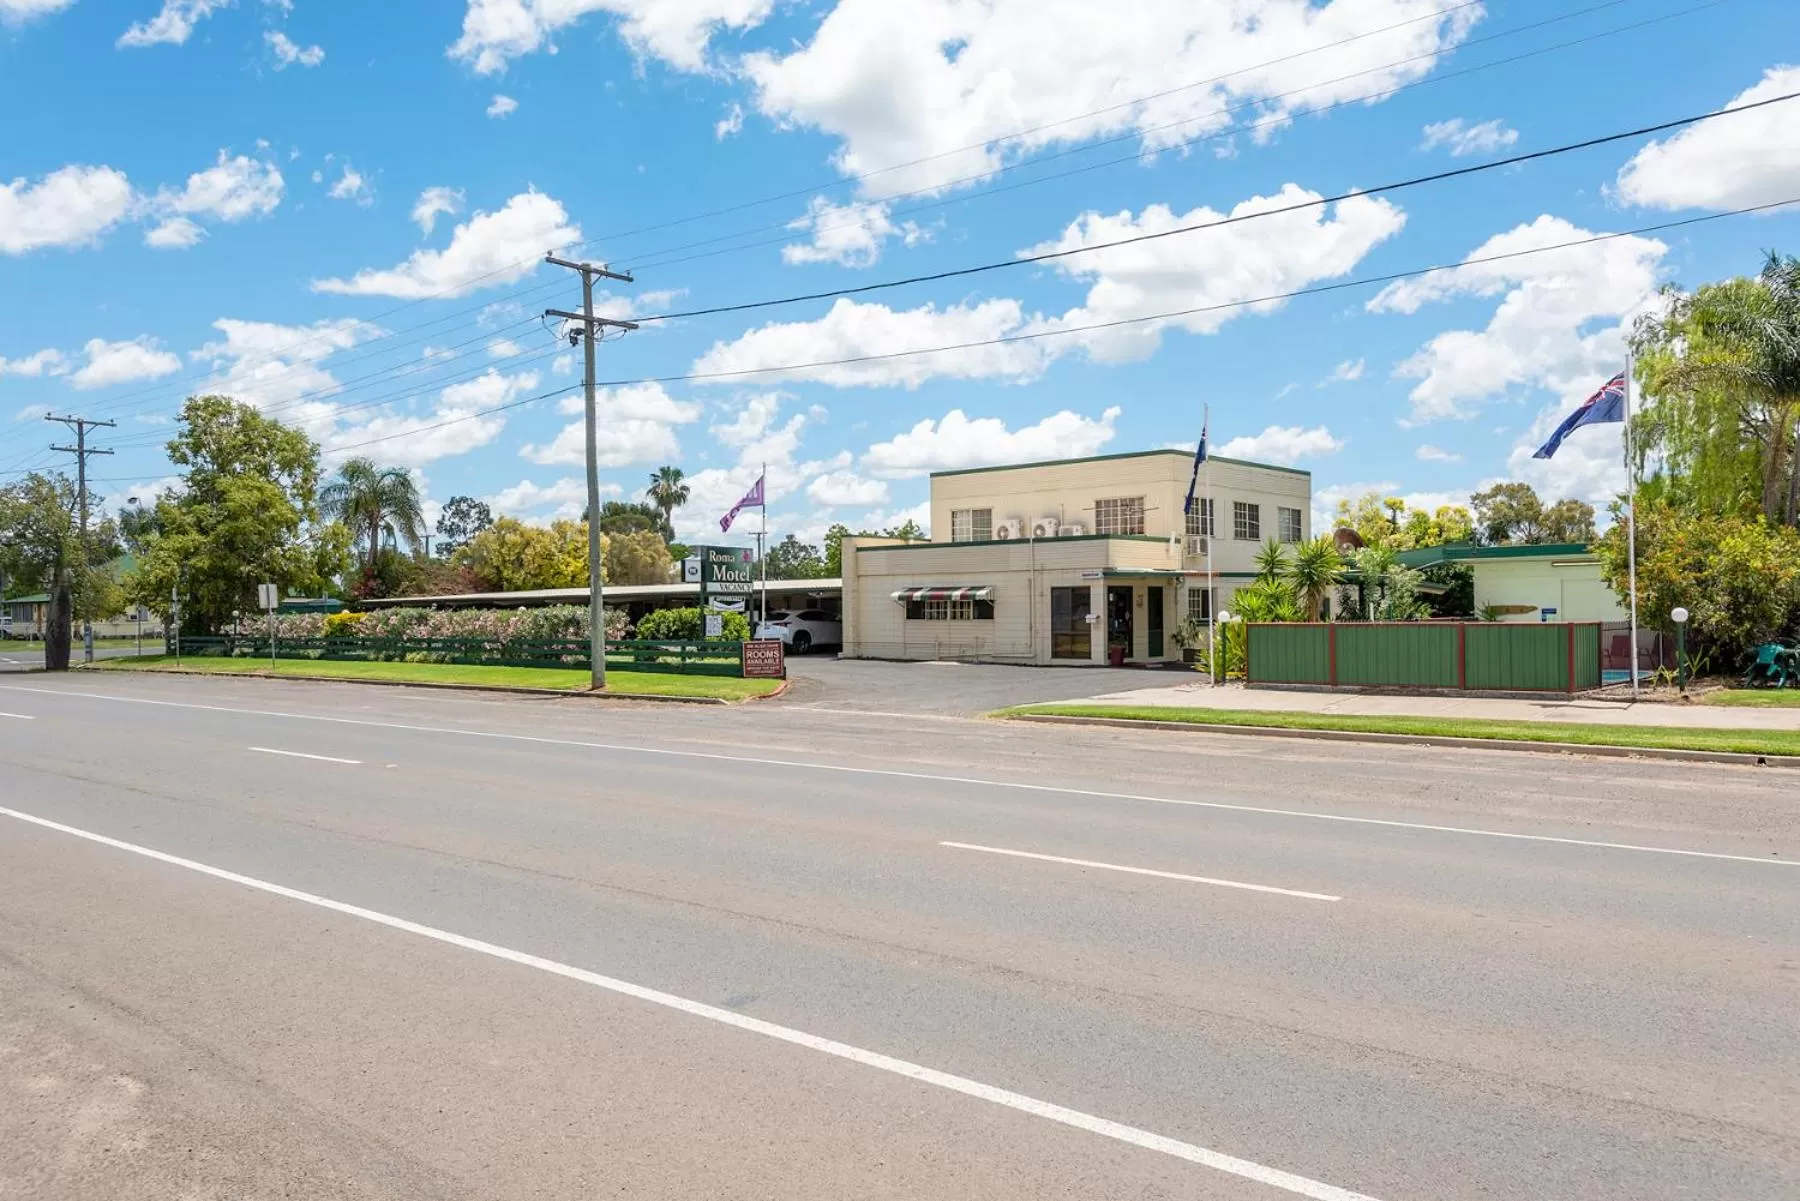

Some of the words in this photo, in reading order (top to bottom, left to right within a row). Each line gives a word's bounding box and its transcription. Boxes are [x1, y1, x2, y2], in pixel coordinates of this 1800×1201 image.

[709, 550, 735, 562] Roma
[712, 565, 750, 581] Motel
[720, 583, 752, 592] VACANCY
[746, 650, 780, 659] ROOMS
